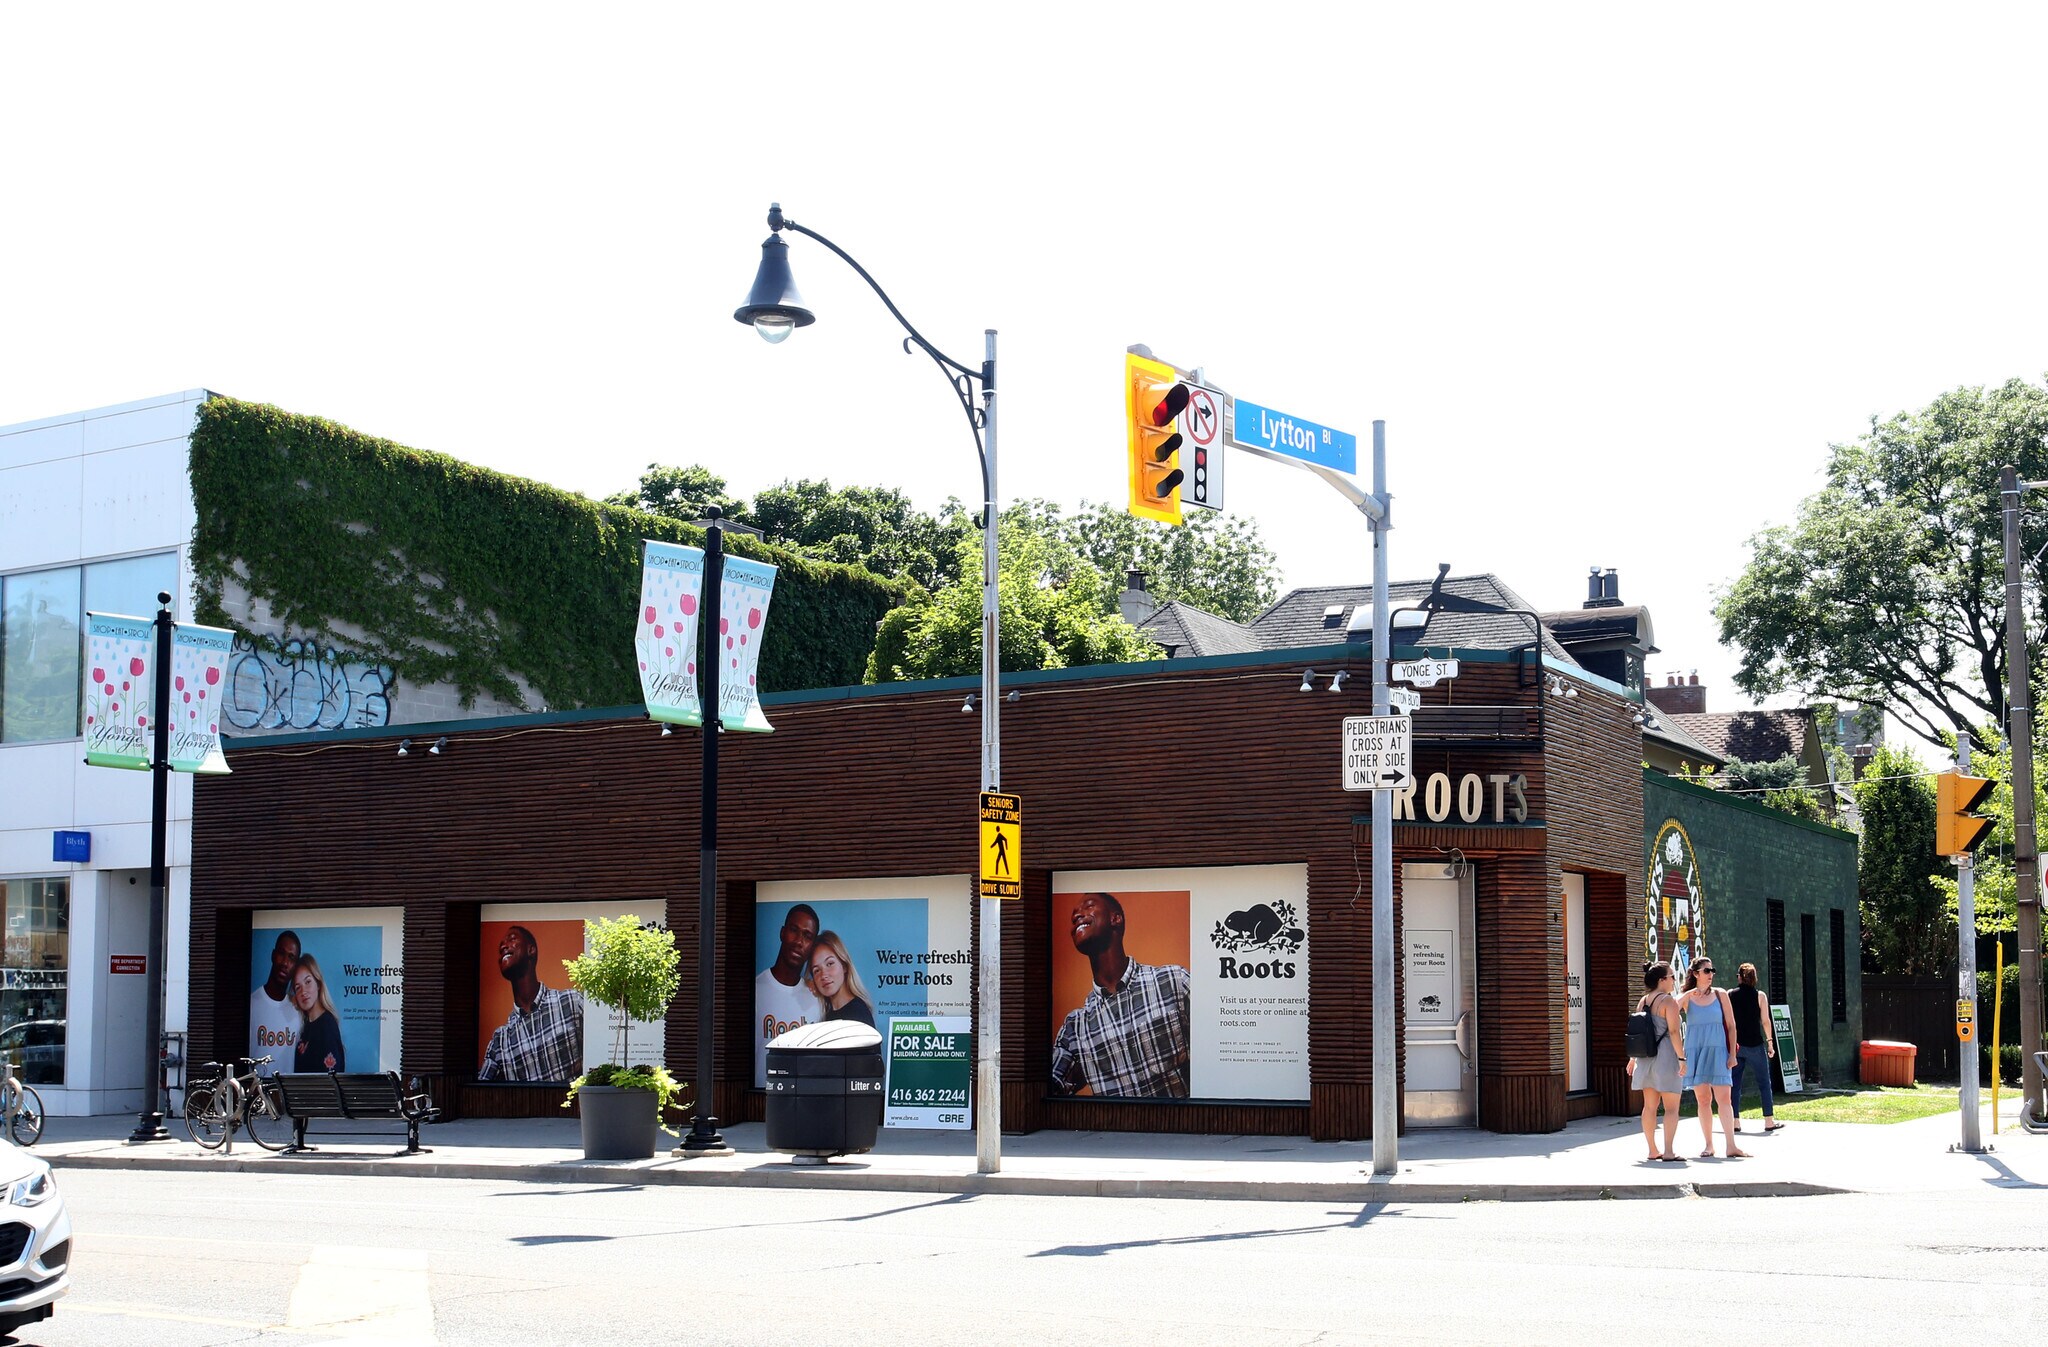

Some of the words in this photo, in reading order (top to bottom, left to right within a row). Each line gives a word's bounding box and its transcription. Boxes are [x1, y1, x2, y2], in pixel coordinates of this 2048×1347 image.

[1261, 409, 1316, 453] Lytton
[1402, 664, 1430, 678] YONGE
[649, 672, 693, 706] Yonge
[720, 683, 756, 716] Yonge
[1346, 720, 1407, 735] PEDESTRIANS
[91, 725, 143, 753] Yonge
[173, 732, 218, 759] Yonge
[1352, 738, 1383, 752] CROSS
[1390, 736, 1402, 750] AT
[1348, 754, 1378, 768] OTHER
[1385, 752, 1406, 766] SIDE
[1354, 770, 1378, 784] ONLY
[988, 797, 1014, 810] SENIORS
[1392, 772, 1528, 824] ROOTS
[982, 808, 1004, 820] SAFETY
[1005, 810, 1020, 822] ZONE
[66, 837, 86, 846] Blyth
[982, 884, 998, 894] DRIVE
[1000, 884, 1019, 895] SLOWLY
[1686, 861, 1703, 960] LODG
[876, 950, 912, 964] We're
[917, 950, 972, 964] refreshi
[344, 964, 372, 976] We're
[374, 964, 404, 976] refres
[1219, 957, 1296, 979] Roots
[878, 974, 910, 988] your
[914, 970, 953, 986] Roots
[344, 985, 368, 998] your
[371, 982, 400, 994] Roots
[1220, 1008, 1240, 1016] Roots
[257, 1025, 296, 1046] Roots
[894, 1036, 920, 1050] FOR
[924, 1036, 954, 1050] SALE
[850, 1081, 870, 1091] Litter
[891, 1088, 912, 1100] 416
[915, 1089, 935, 1101] 362
[938, 1089, 966, 1101] 2244
[938, 1114, 964, 1123] CBRE
